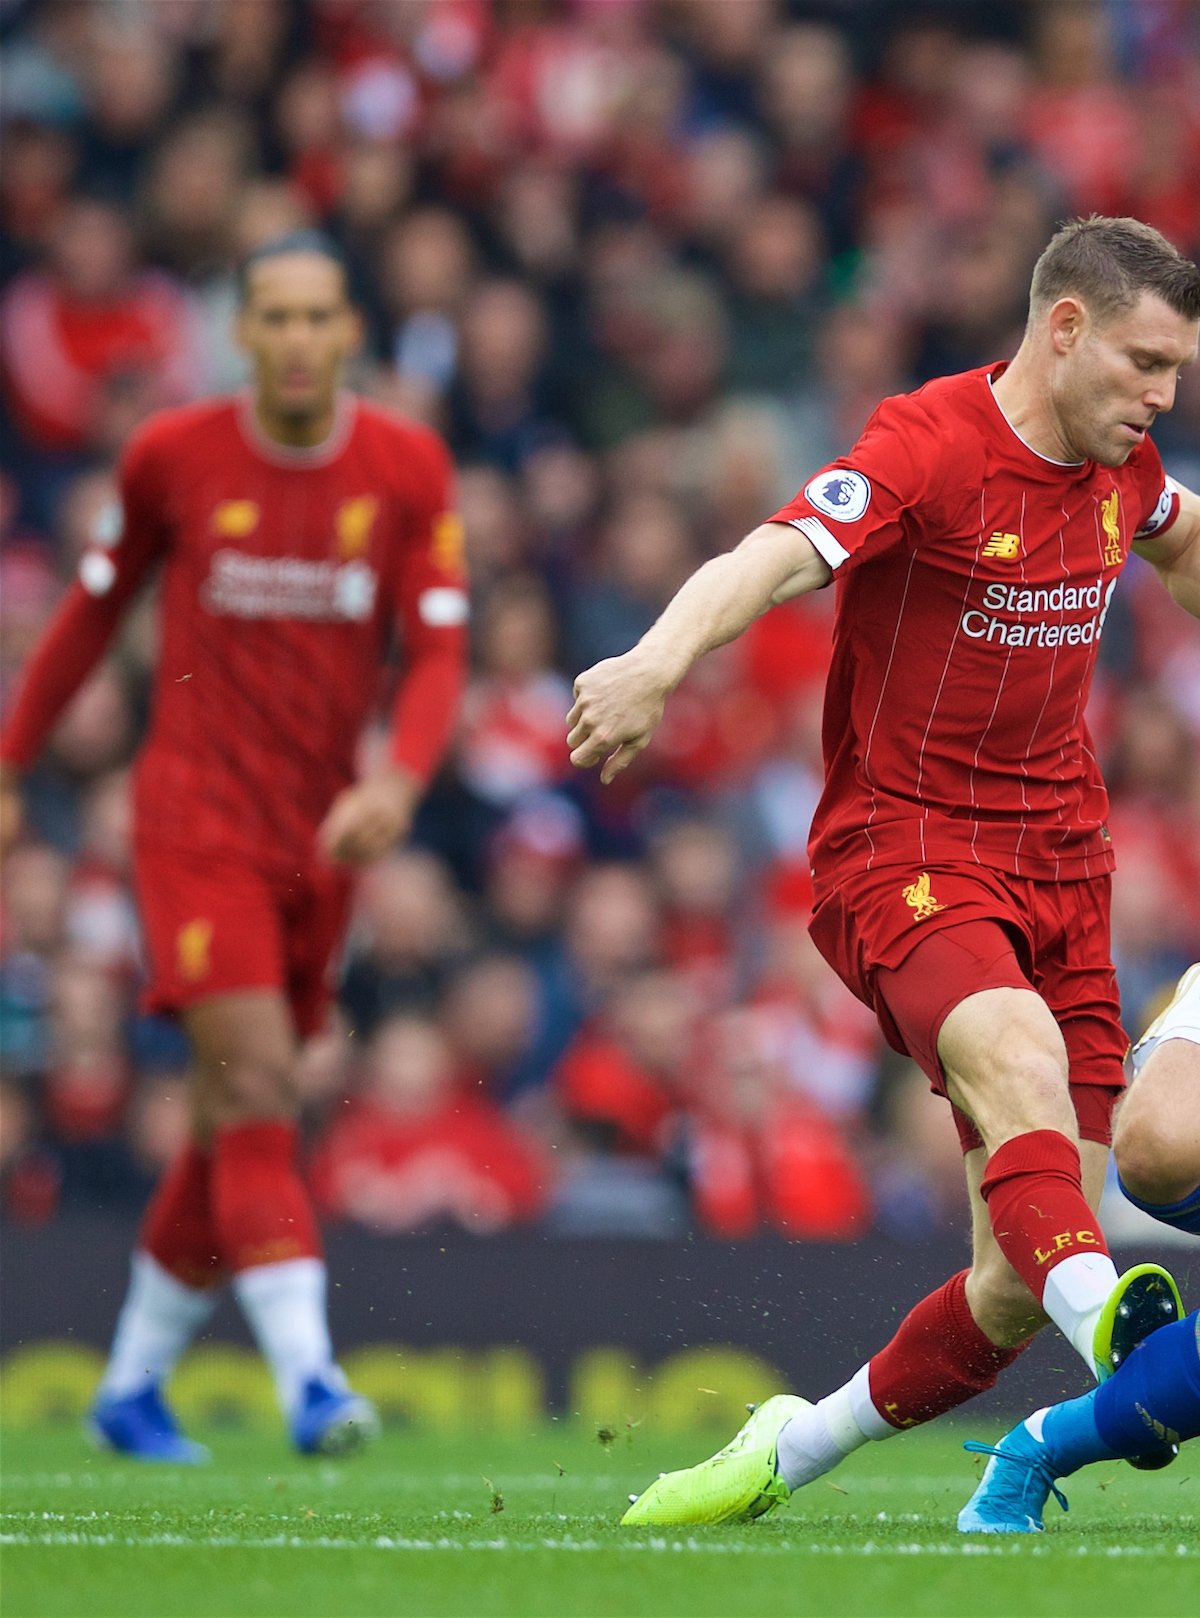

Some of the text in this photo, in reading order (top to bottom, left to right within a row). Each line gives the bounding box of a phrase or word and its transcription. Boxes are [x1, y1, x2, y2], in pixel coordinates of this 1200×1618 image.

[1104, 549, 1123, 566] LFC
[982, 579, 1102, 612] Standard
[961, 610, 1097, 647] Chartered
